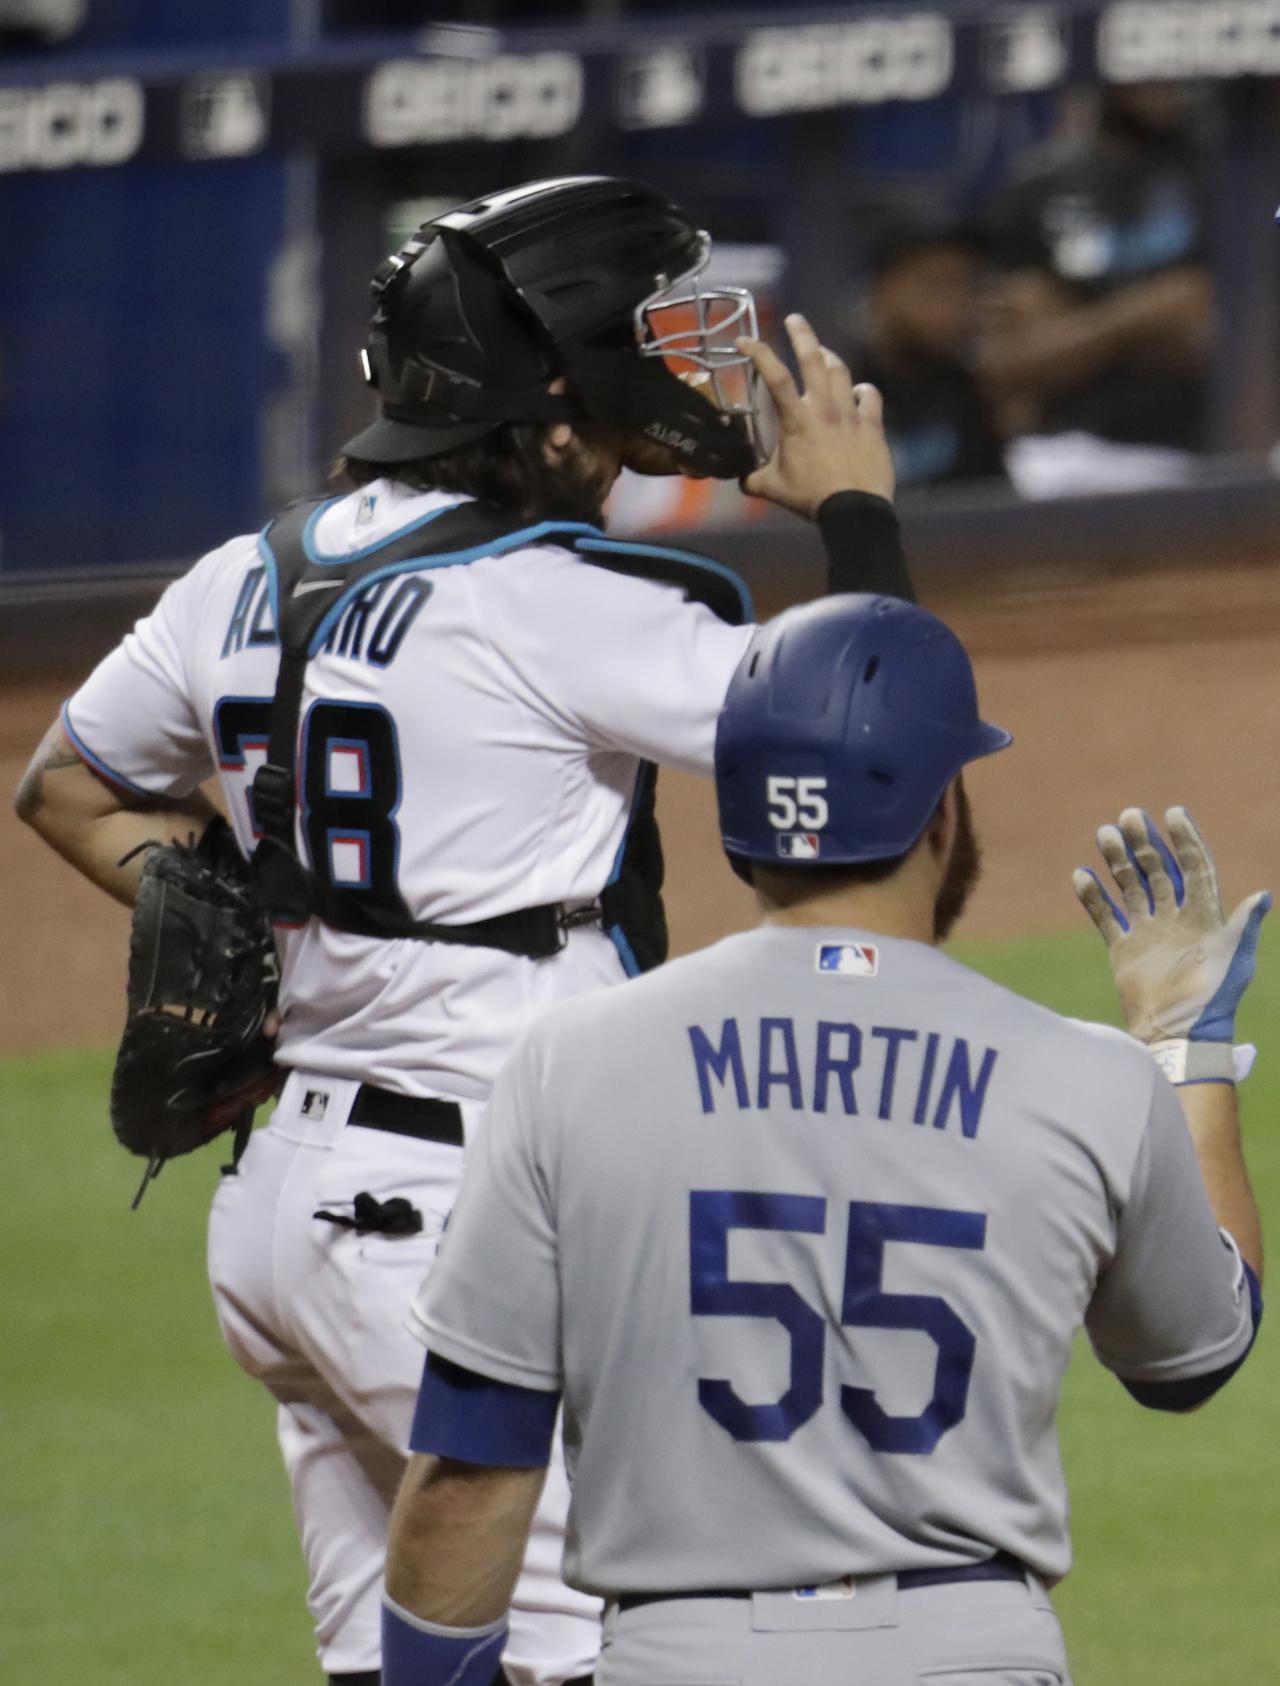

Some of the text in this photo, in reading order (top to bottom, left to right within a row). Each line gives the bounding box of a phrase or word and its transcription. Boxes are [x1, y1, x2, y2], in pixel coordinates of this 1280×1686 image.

[368, 52, 583, 147] GEICO
[738, 12, 953, 116] GEICO
[766, 775, 829, 830] 55
[687, 1017, 998, 1139] MARTIN
[689, 1189, 987, 1454] 55
